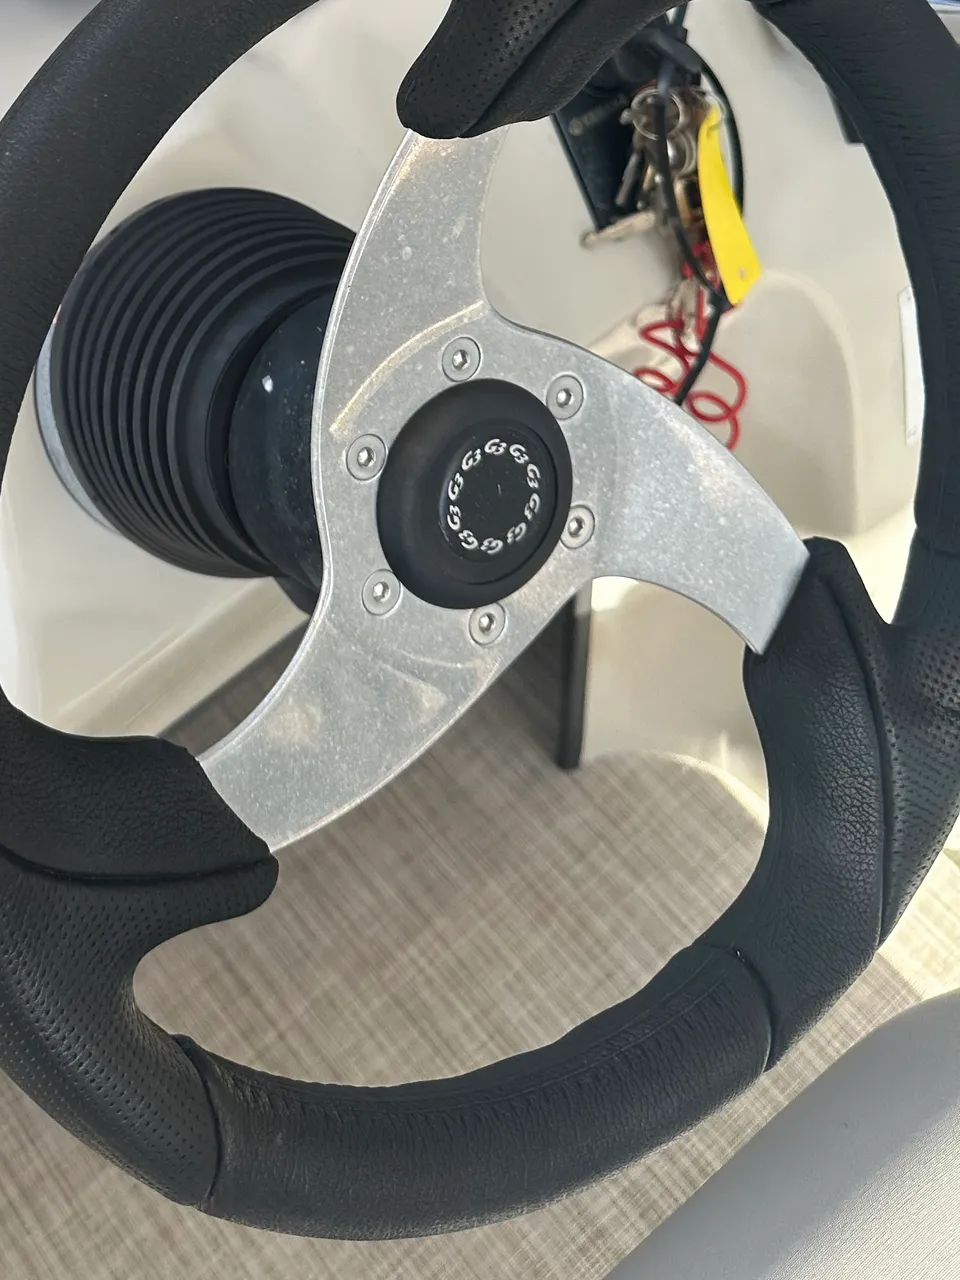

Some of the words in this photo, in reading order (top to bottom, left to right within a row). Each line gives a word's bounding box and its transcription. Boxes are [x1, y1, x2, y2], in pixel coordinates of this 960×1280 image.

[484, 438, 507, 456] G3
[509, 443, 529, 464] G3
[461, 448, 482, 471] G3
[448, 472, 464, 501] G3
[526, 463, 541, 489] G3
[524, 493, 541, 520] G3
[446, 505, 461, 531] G3
[458, 529, 479, 550] G3
[506, 522, 527, 544] G3
[480, 538, 503, 554] G3
